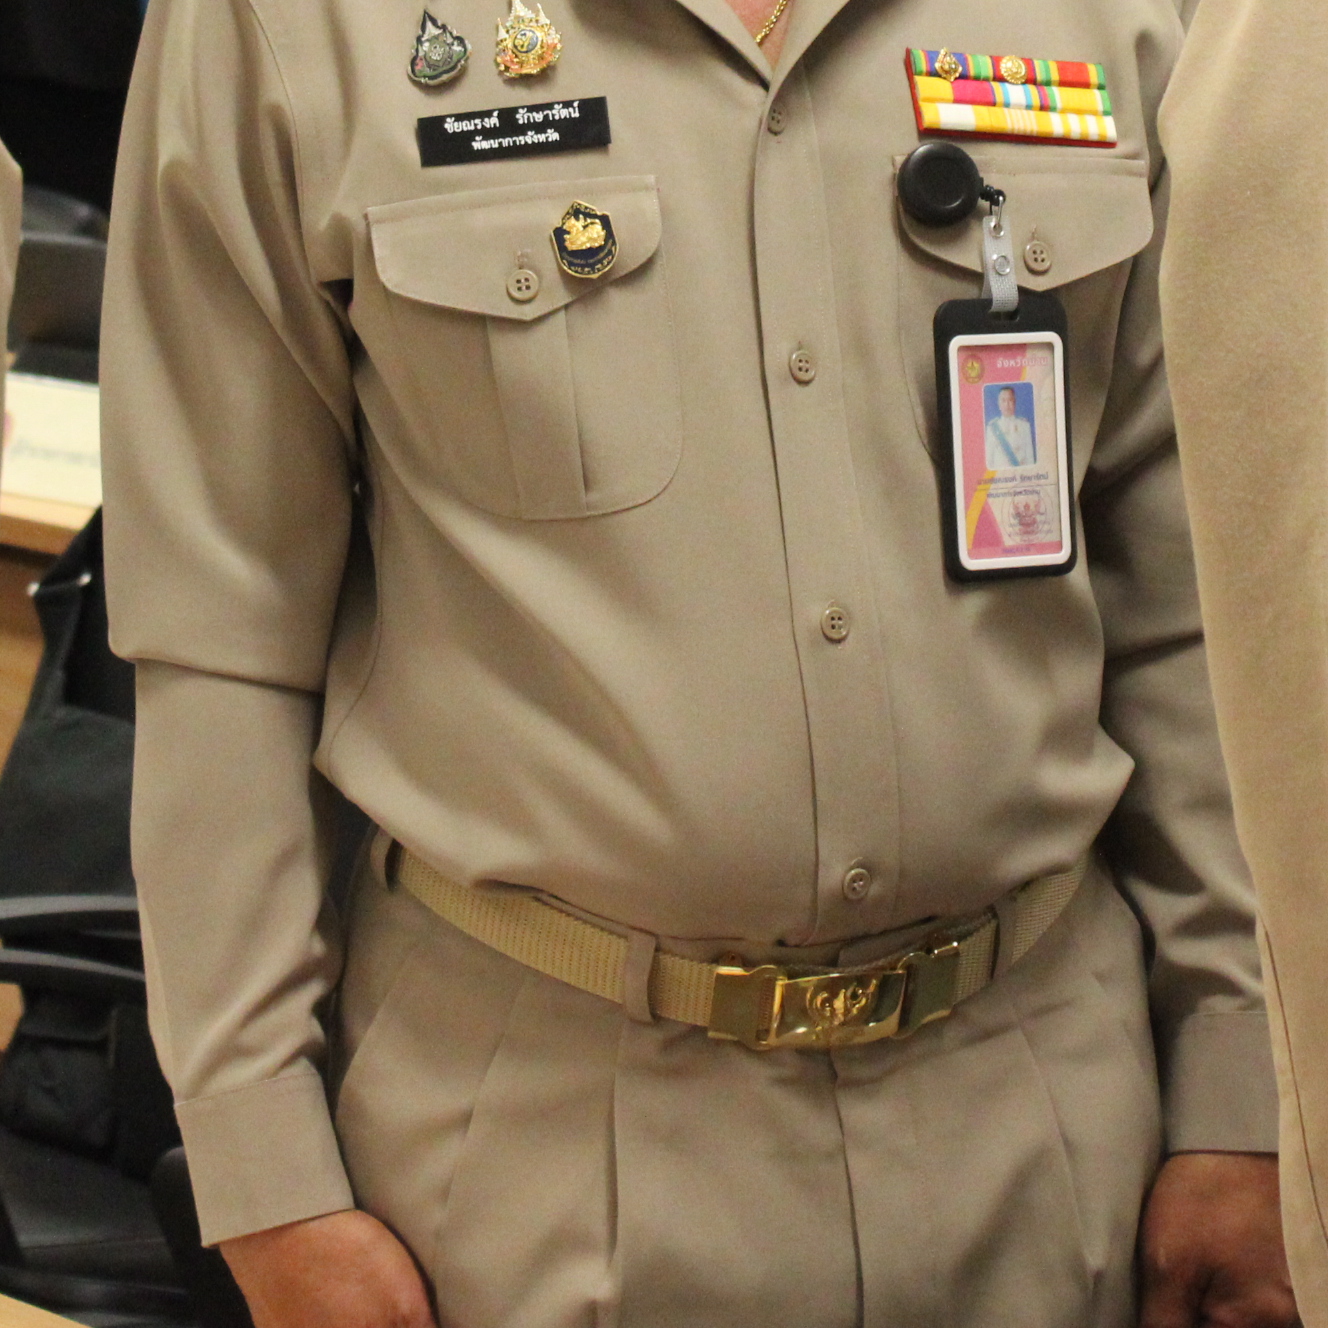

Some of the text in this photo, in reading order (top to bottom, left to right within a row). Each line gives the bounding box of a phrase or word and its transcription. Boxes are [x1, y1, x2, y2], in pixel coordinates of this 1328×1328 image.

[443, 101, 580, 134] ชัยณรงค์ รักษารัตน์
[471, 128, 560, 151] พัฒนาการจังหวัด
